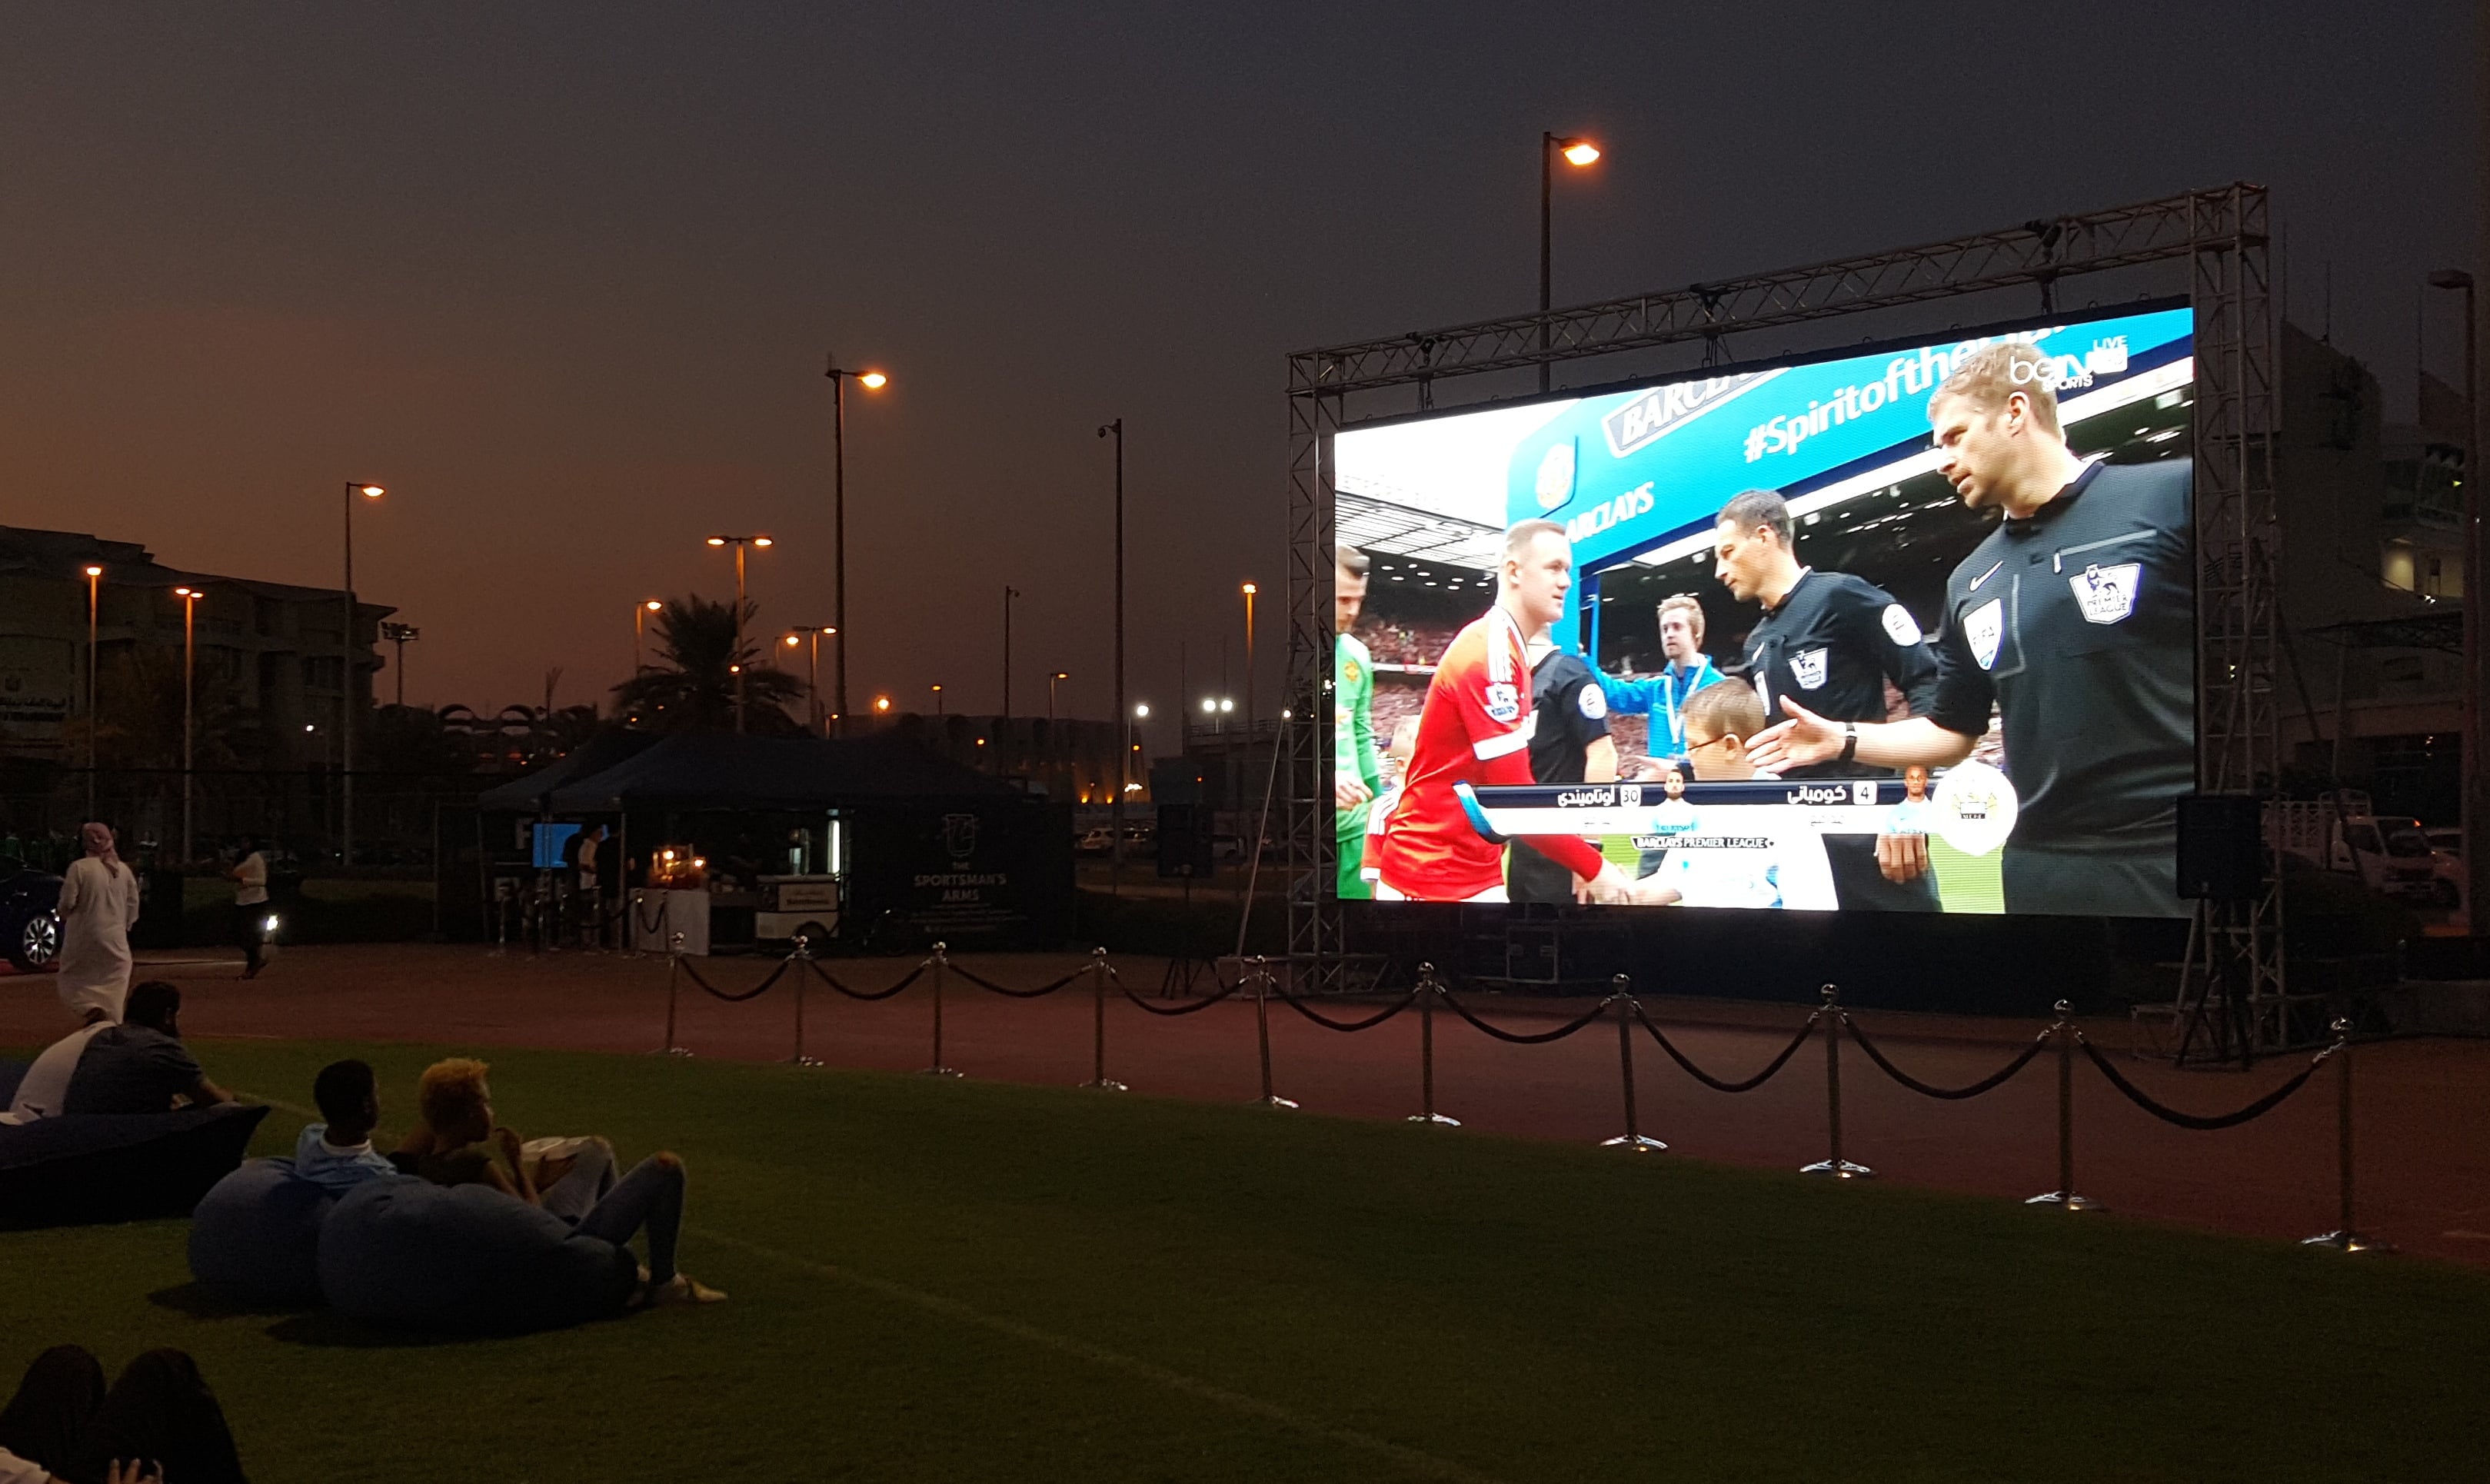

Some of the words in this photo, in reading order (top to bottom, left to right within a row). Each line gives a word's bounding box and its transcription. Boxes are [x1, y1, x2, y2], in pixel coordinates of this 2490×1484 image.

[2093, 334, 2128, 348] LIVE
[2042, 373, 2093, 392] SPORTS
[2090, 602, 2127, 616] LEAGUE
[1623, 790, 1639, 803] 30
[1860, 786, 1870, 800] 4
[1636, 837, 1683, 849] BARCLAYS
[1683, 838, 1725, 849] PREMIER
[1727, 838, 1765, 849] LEAGUE
[913, 873, 1008, 887] SPORTSMAN'S
[941, 888, 980, 903] ARMS
